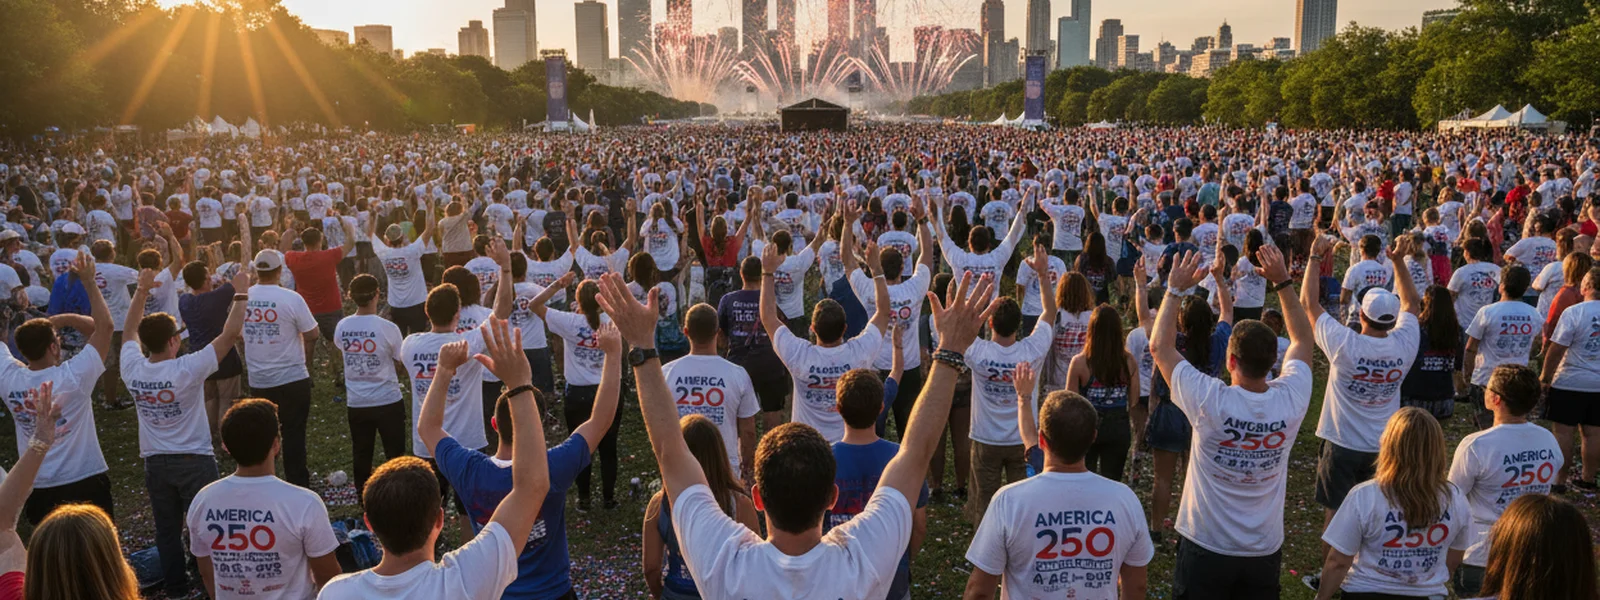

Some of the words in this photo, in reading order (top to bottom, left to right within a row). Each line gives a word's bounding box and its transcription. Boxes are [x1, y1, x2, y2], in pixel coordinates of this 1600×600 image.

[676, 387, 725, 407] 250
[1219, 428, 1286, 450] 250
[1501, 462, 1554, 488] 250
[205, 508, 275, 523] AMERICA
[1035, 510, 1116, 527] AMERICA
[207, 524, 276, 551] 250
[1036, 527, 1115, 559] 250
